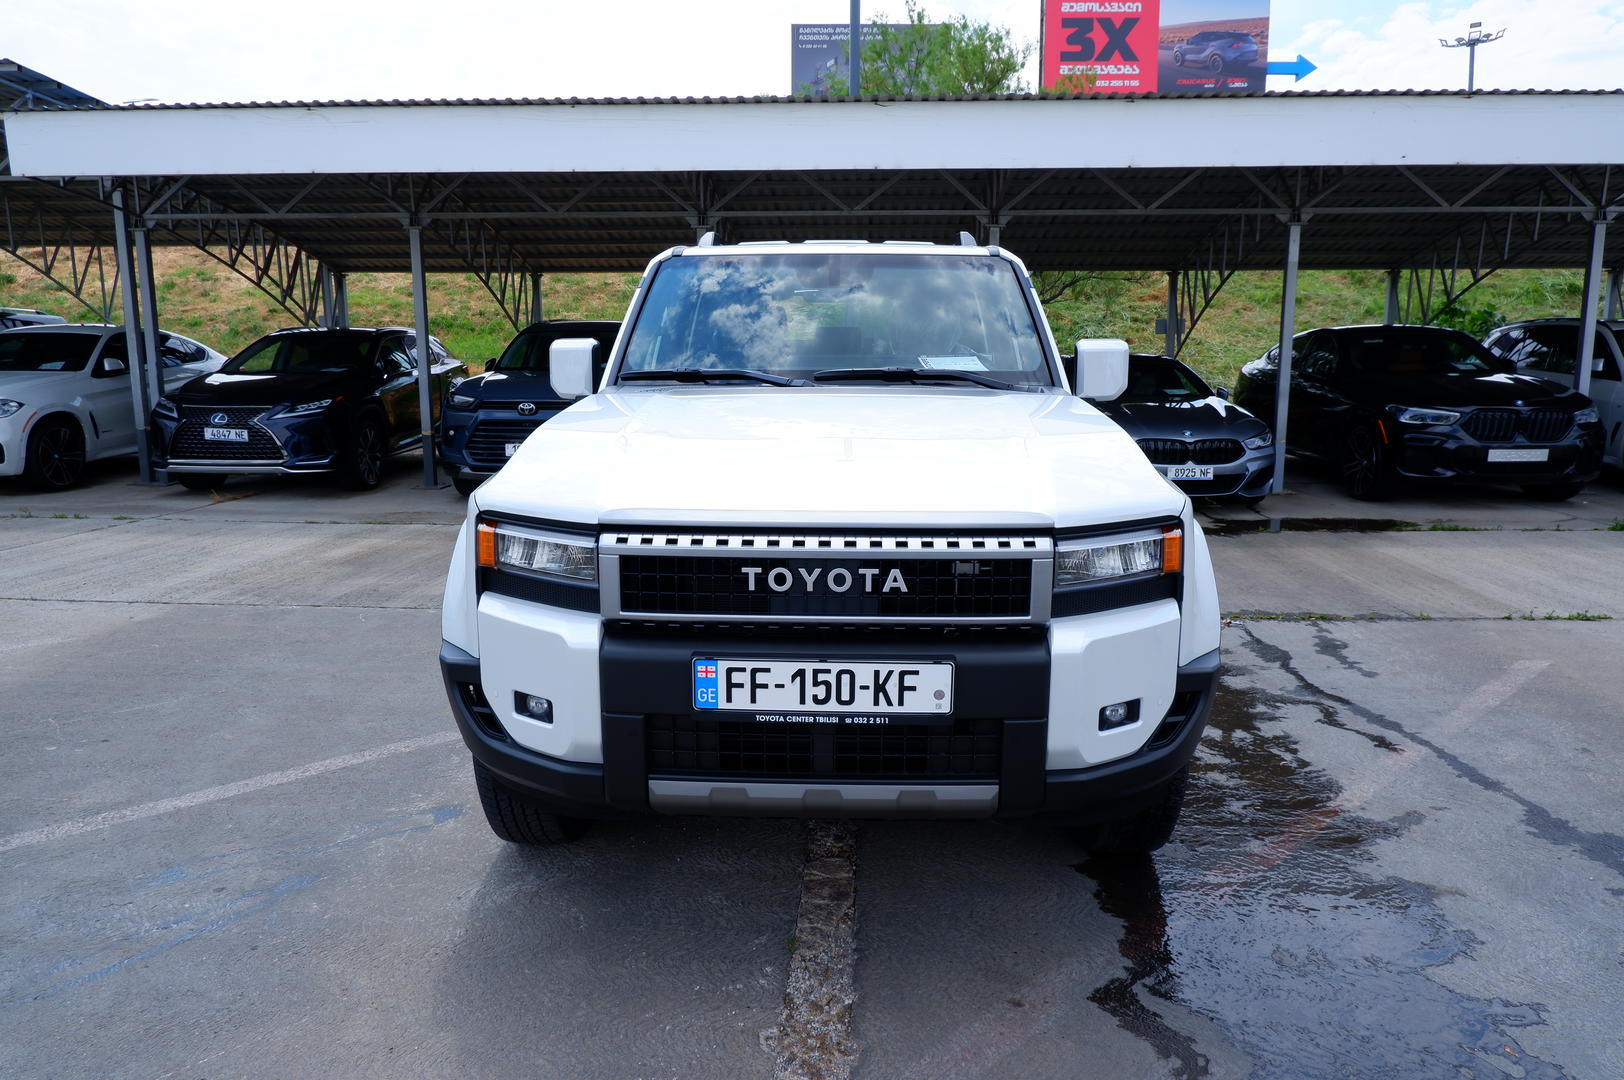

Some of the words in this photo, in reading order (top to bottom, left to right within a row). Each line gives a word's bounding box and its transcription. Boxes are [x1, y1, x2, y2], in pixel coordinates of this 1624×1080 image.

[1060, 17, 1141, 62] 3X
[211, 429, 231, 438] 4847
[235, 430, 246, 439] NE
[1174, 467, 1197, 477] 8925
[1200, 467, 1211, 477] NF
[741, 567, 909, 593] TOYOTA
[697, 688, 717, 703] GE
[725, 666, 920, 707] FF-150-KF
[755, 714, 785, 722] TOYOTA
[786, 715, 814, 723] CENTER
[816, 716, 839, 724] TBILISI
